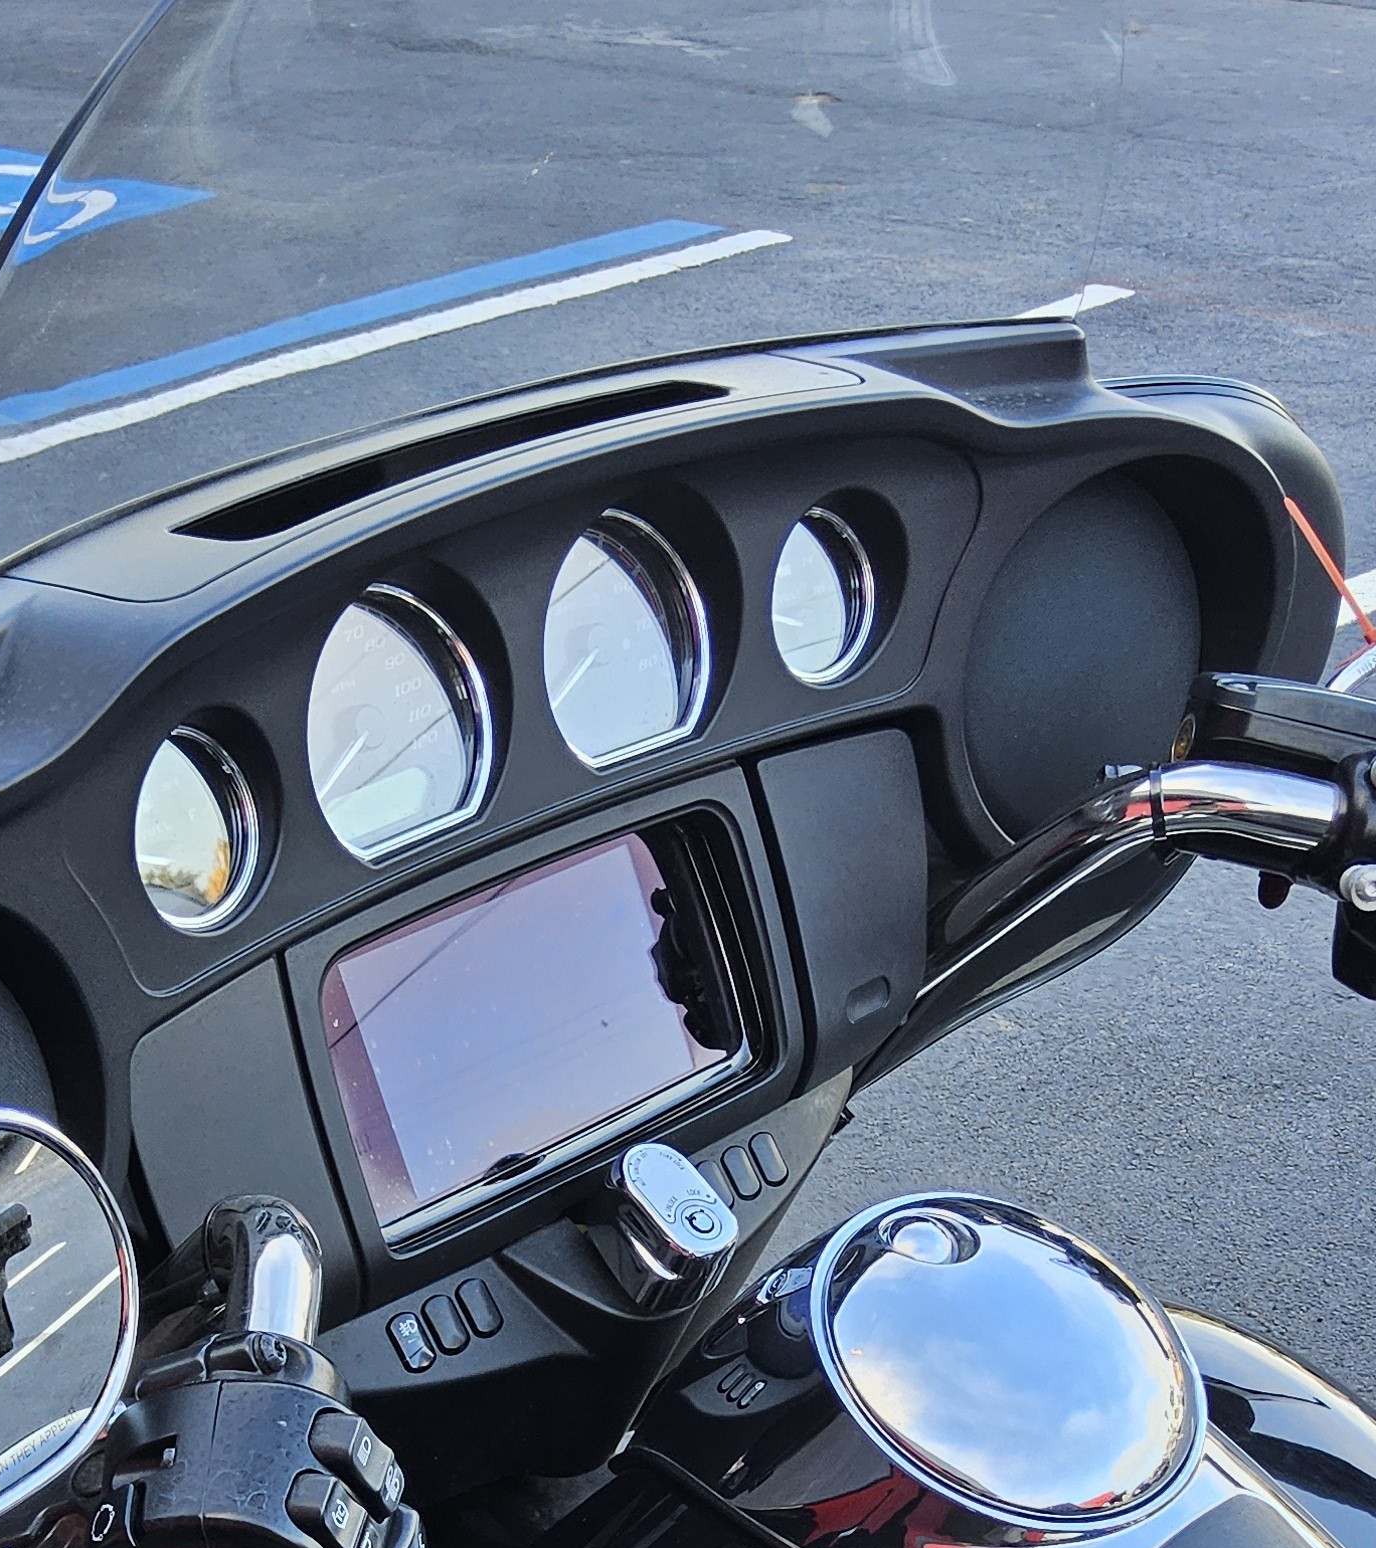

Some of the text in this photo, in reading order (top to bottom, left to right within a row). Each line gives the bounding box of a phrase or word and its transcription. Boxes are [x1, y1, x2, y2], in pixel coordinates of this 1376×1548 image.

[384, 653, 405, 671] 90
[394, 676, 422, 698] 100
[407, 703, 432, 723] 110
[8, 1439, 38, 1466] THEY
